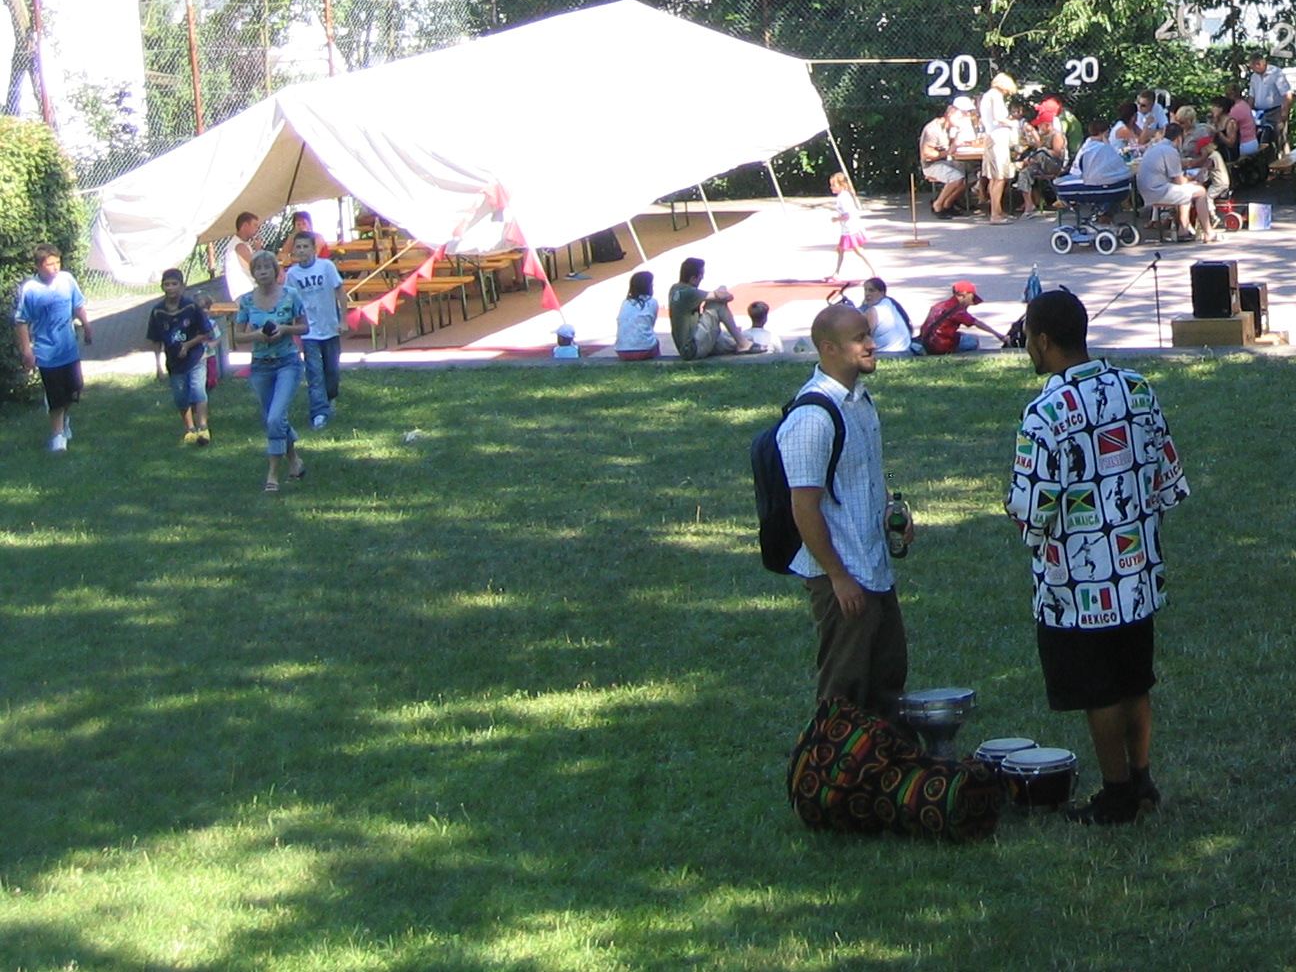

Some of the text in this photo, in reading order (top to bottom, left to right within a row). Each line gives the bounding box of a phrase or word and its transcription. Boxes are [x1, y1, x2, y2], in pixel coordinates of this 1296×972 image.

[927, 54, 977, 97] 20
[1064, 56, 1099, 86] 20
[1081, 612, 1118, 625] MEXICO
